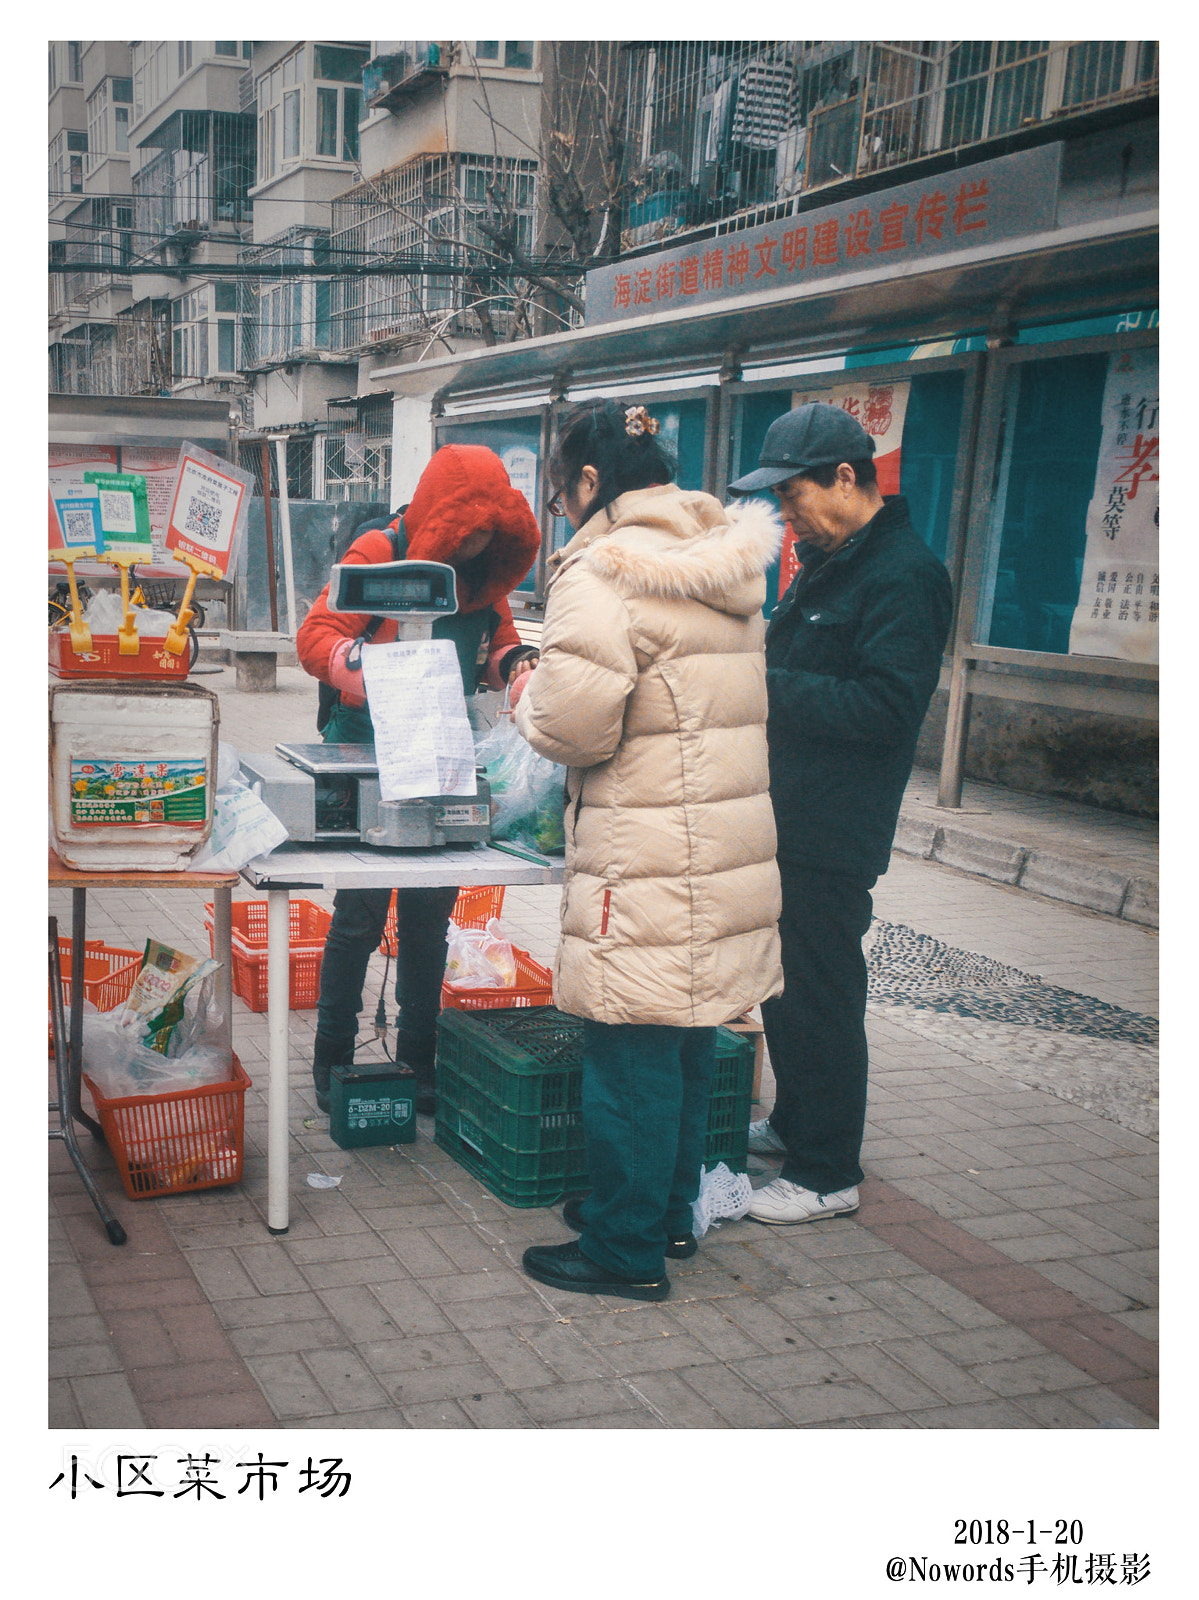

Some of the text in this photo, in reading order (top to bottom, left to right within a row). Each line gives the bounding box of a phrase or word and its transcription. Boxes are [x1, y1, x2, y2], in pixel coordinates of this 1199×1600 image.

[613, 179, 989, 310] 海淀街道精神文明建设宣传栏
[348, 1103, 390, 1113] 6-DZM-20
